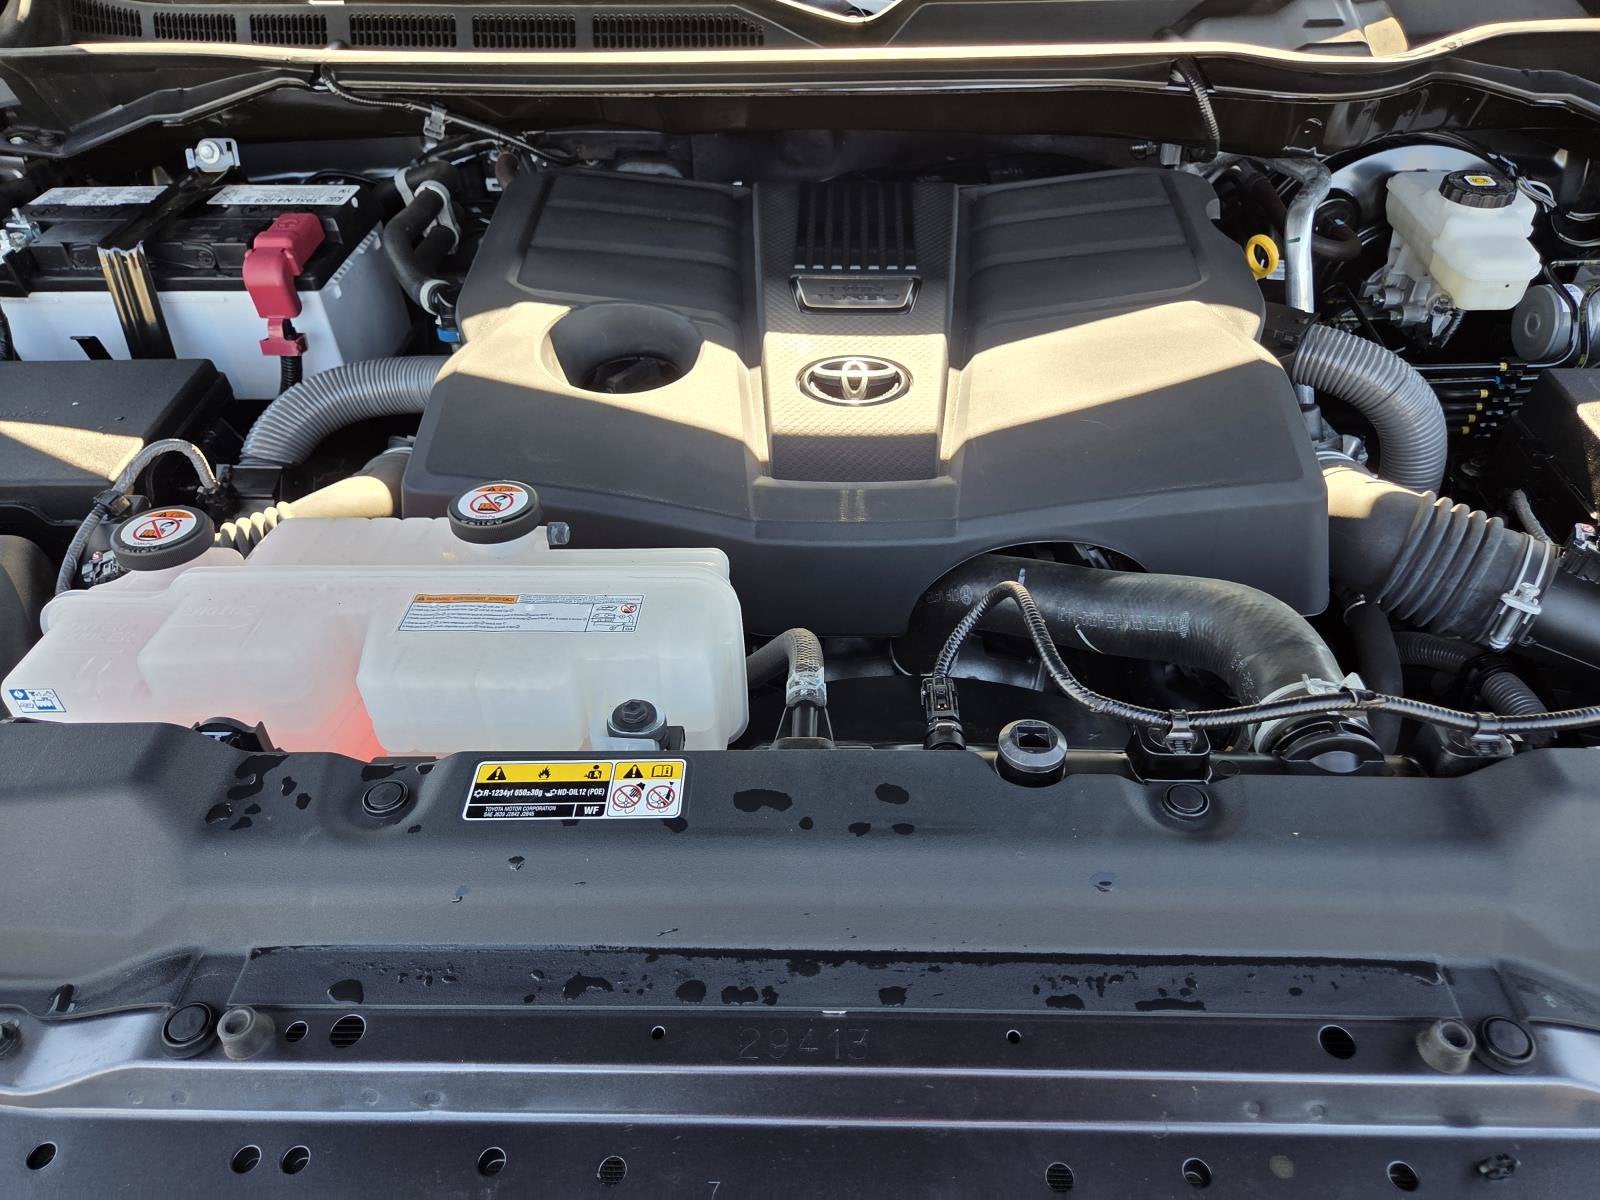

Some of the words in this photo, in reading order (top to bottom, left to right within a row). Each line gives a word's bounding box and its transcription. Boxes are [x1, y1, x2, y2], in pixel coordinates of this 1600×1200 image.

[483, 789, 514, 797] R-1234yf
[587, 788, 605, 797] (POE)
[584, 806, 600, 815] WF
